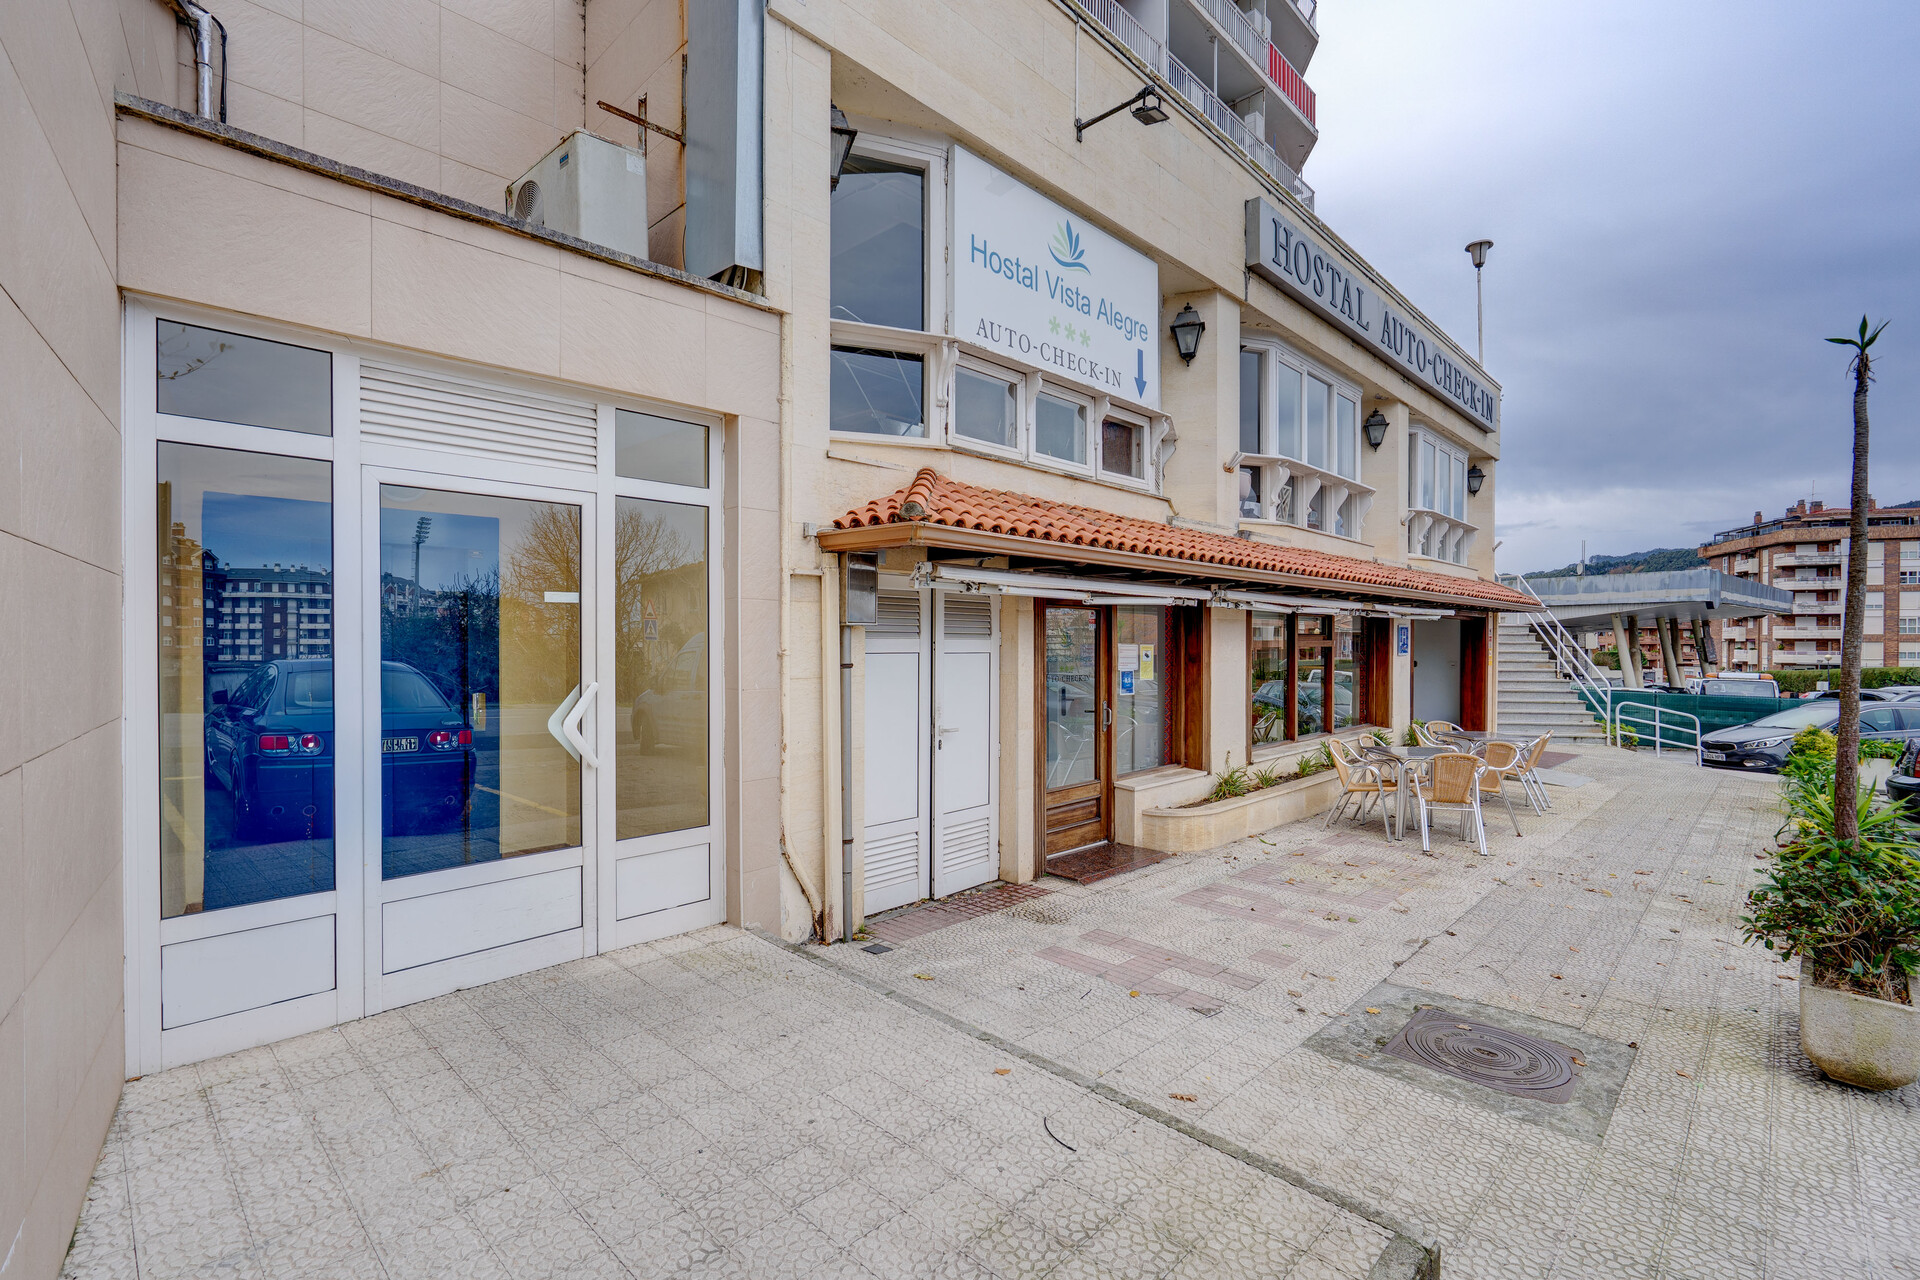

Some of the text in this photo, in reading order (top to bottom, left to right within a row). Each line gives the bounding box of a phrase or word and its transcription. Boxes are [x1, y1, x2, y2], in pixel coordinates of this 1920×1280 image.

[971, 233, 1148, 342] Hostal Vista Alegre
[1272, 217, 1494, 424] HOSTAL AUTO-CHECK-IN
[976, 318, 1122, 388] AUTO-CHECK-IN
